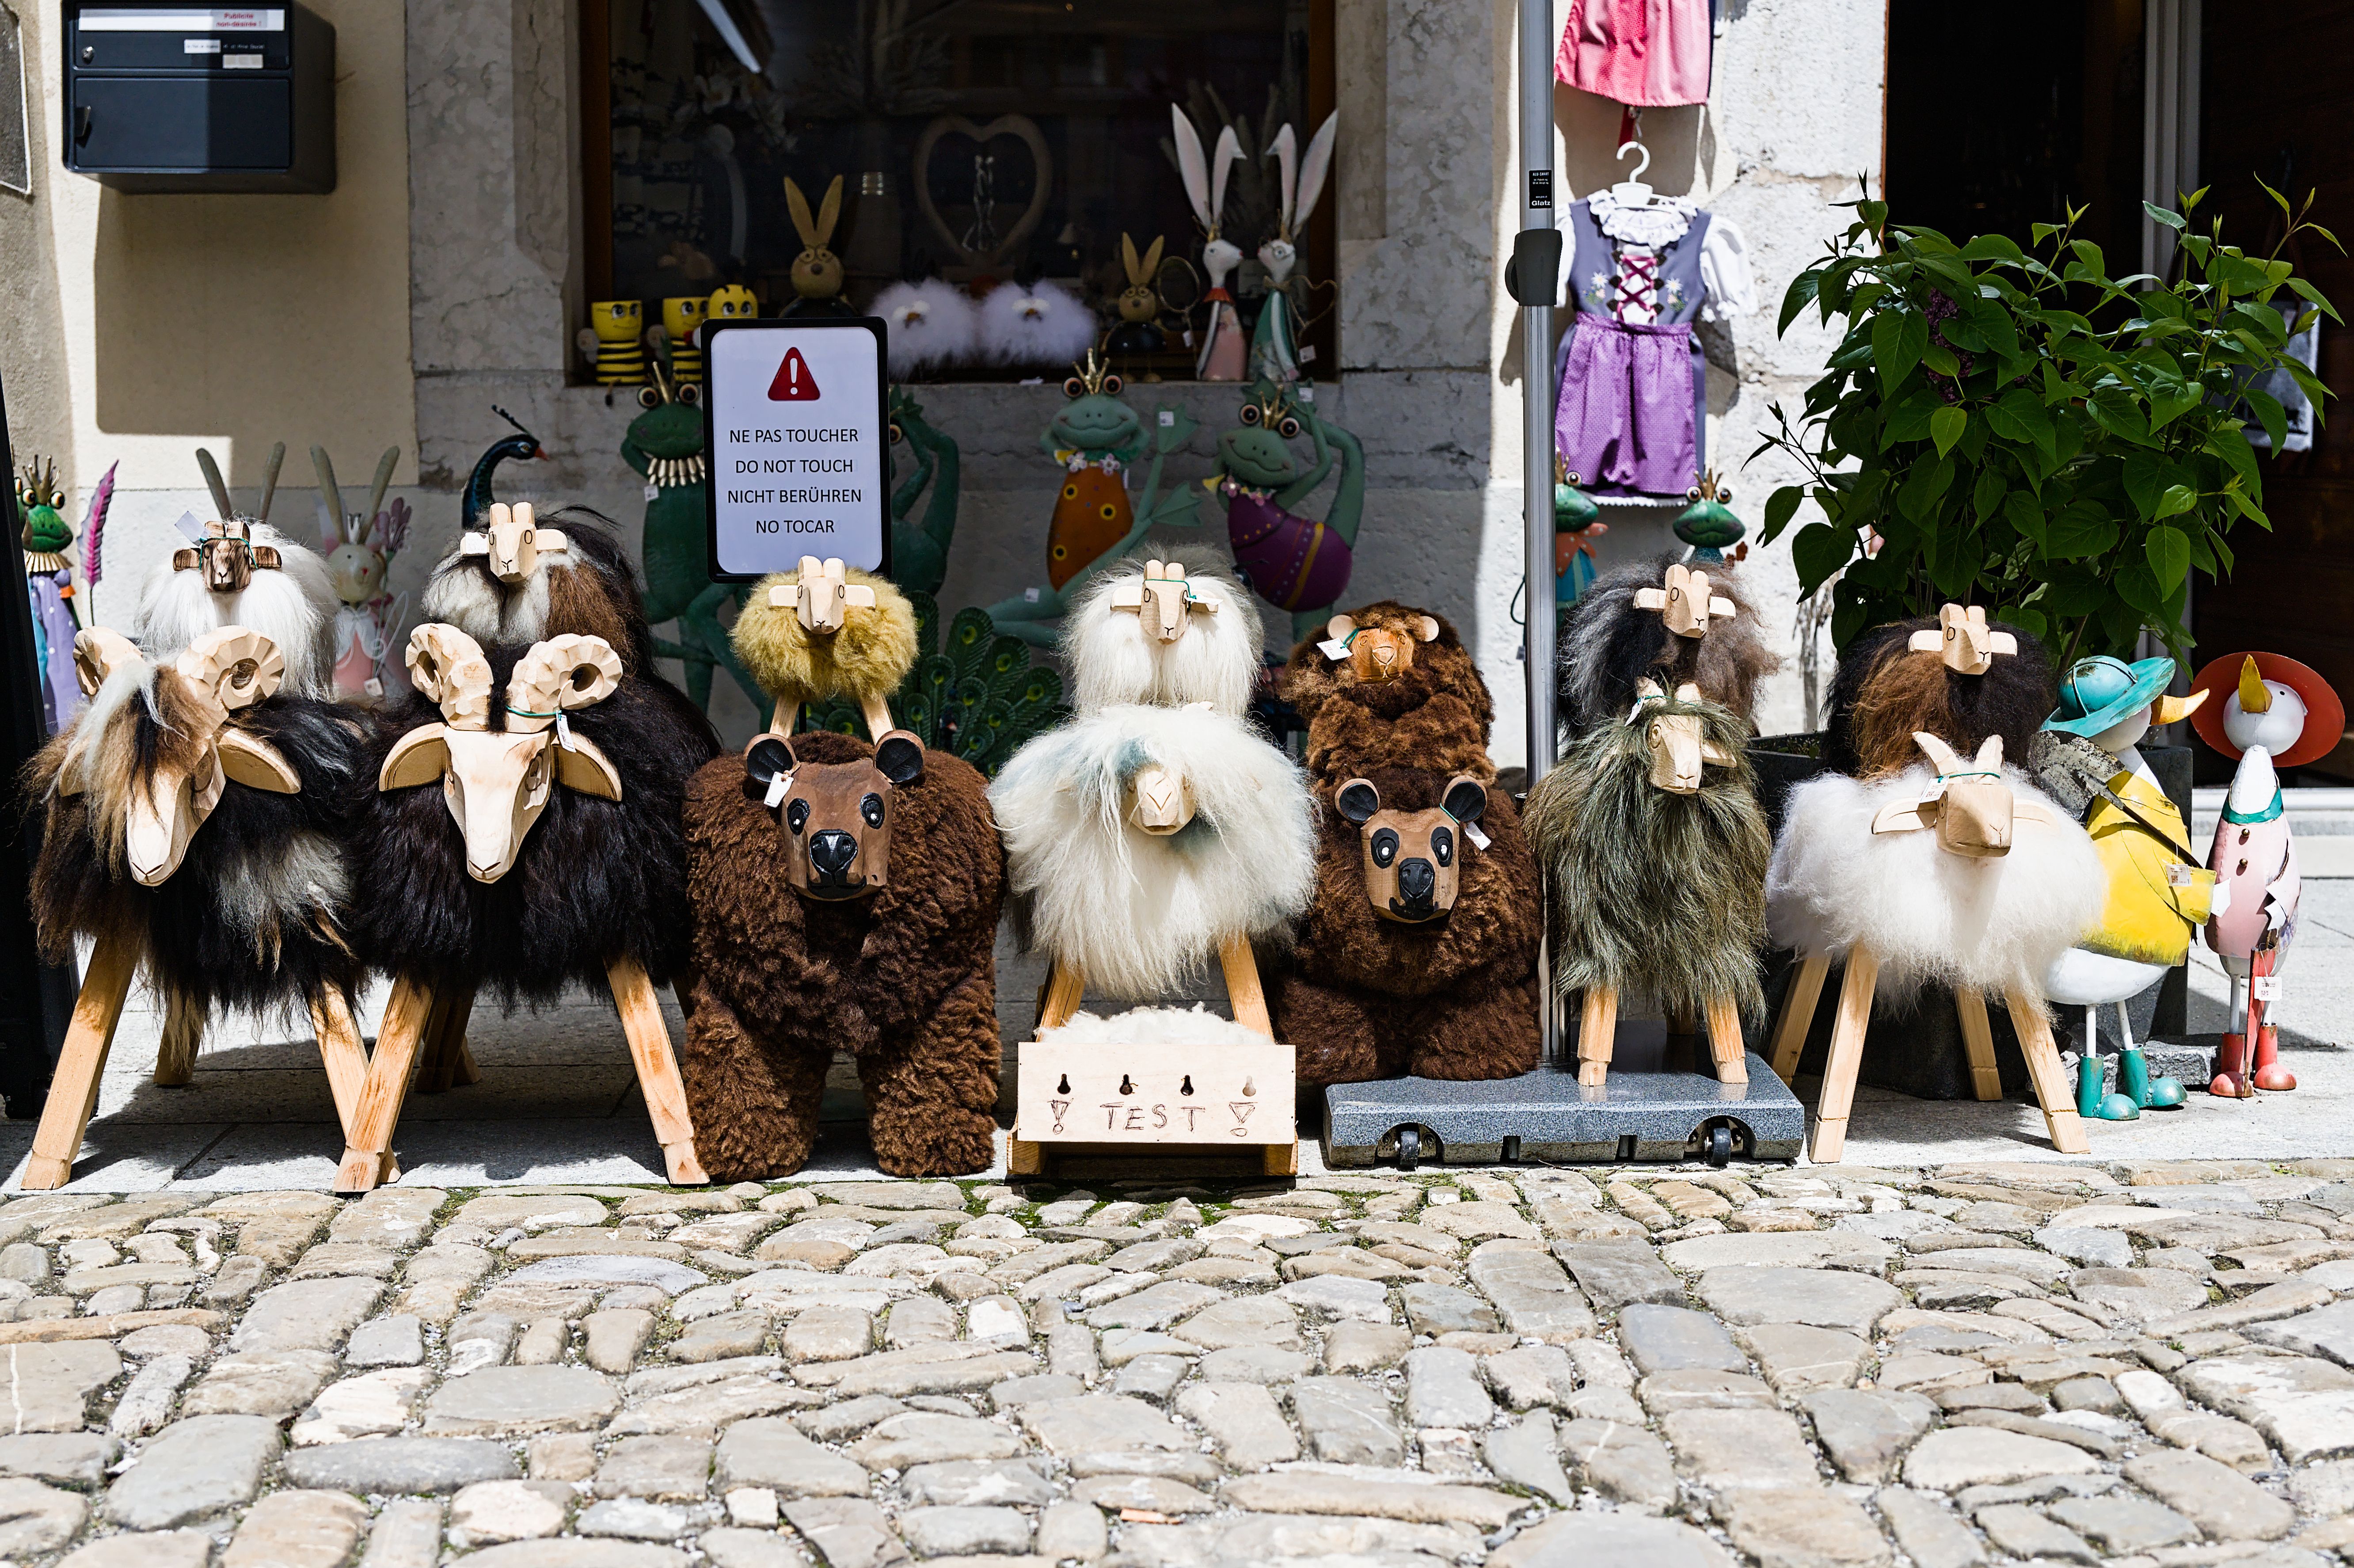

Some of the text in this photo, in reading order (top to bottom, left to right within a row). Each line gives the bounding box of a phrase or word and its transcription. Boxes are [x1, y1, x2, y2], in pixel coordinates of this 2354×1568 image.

[730, 429, 859, 443] NE PAS TOUCHER
[736, 459, 853, 473] DO NOT TOUCH
[728, 487, 861, 503] NICHT BERÜHREN
[756, 520, 834, 533] NO TOCAR
[1099, 1102, 1206, 1133] TEST
